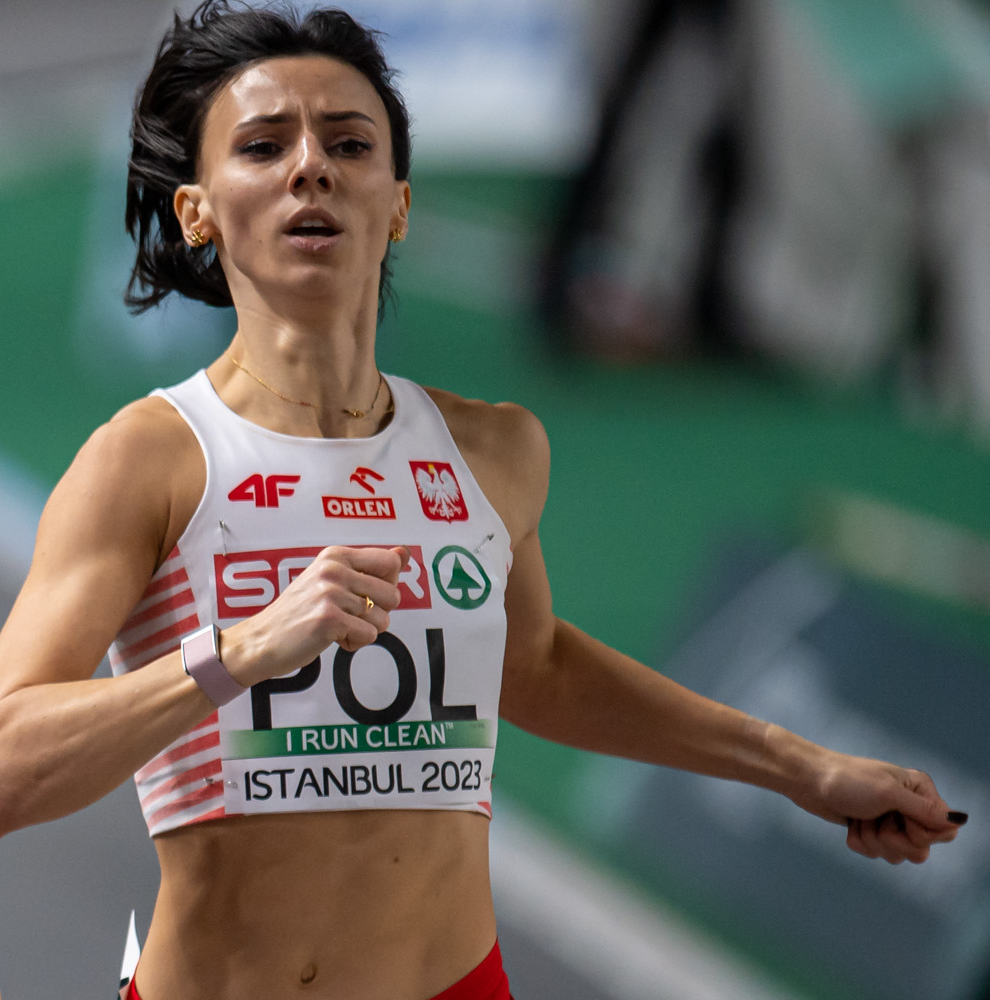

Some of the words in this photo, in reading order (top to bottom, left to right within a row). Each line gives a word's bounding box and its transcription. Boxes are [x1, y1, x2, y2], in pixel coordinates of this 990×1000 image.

[227, 473, 301, 508] 4F
[327, 499, 391, 517] ORLEN
[286, 730, 293, 751] I
[302, 727, 358, 751] RUN
[245, 763, 414, 801] ISTANBUL
[421, 760, 482, 793] 2023
